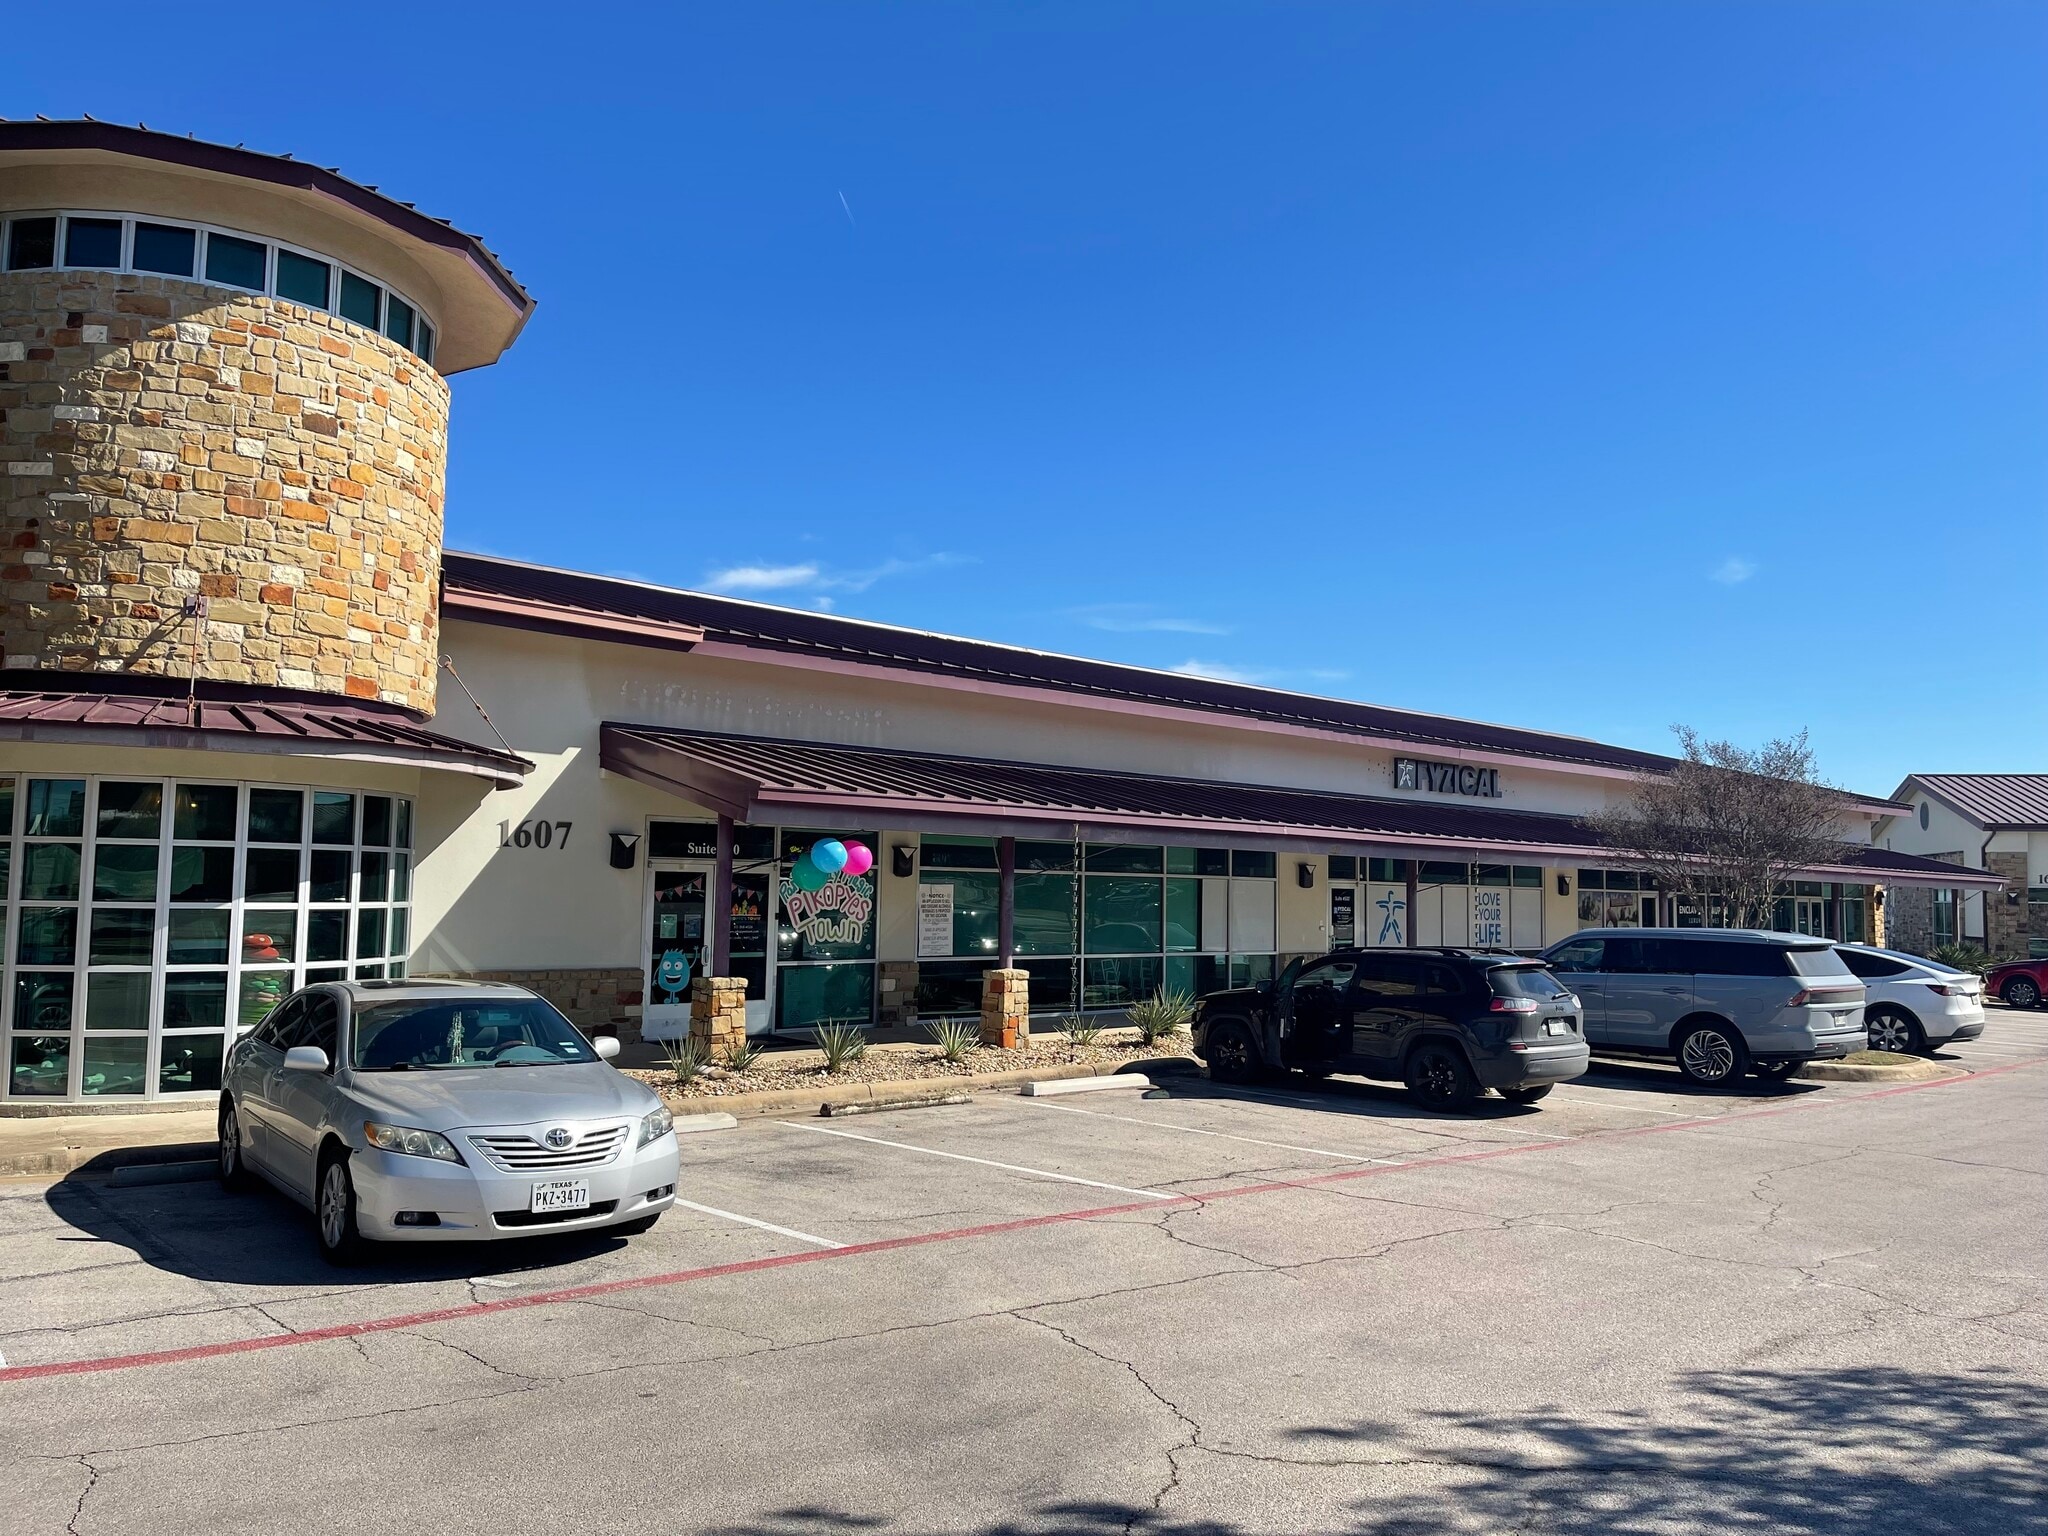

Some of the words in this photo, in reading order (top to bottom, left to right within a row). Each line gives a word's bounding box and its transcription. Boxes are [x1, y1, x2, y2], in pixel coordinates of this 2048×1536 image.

[1415, 761, 1502, 798] FYZICAL
[496, 819, 572, 850] 1607
[687, 842, 717, 854] Suite
[1478, 892, 1500, 906] LOVE
[1479, 908, 1501, 921] YOUR
[1679, 905, 1697, 914] ENCLAV
[1478, 923, 1501, 943] LIFE
